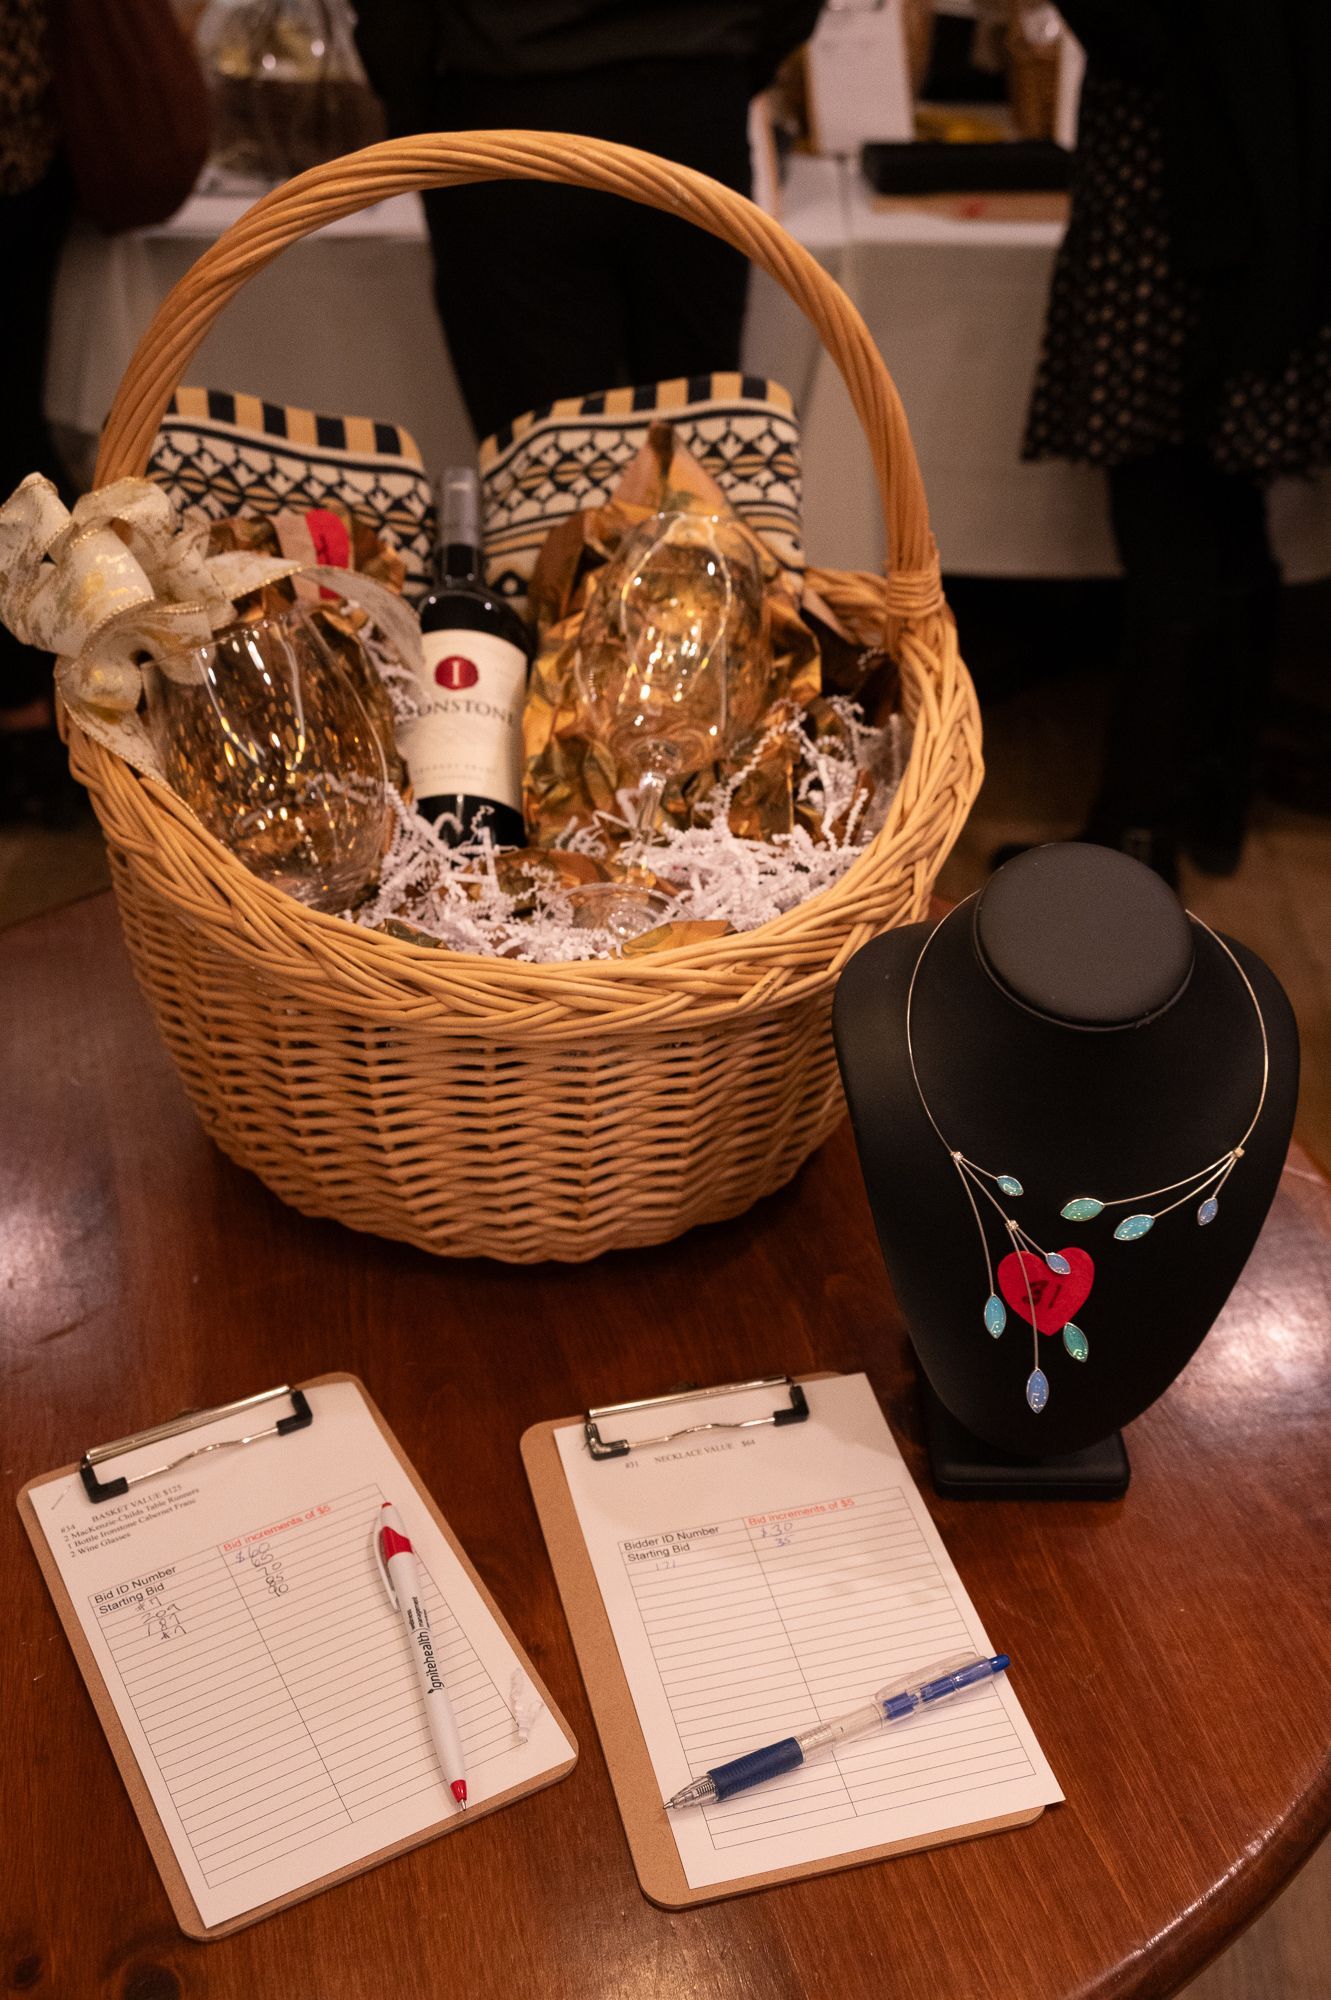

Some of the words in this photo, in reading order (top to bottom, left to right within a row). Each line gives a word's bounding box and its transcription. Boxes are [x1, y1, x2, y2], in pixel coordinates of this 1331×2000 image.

[414, 699, 514, 725] ONSTONE
[654, 1449, 702, 1464] NECKLACE
[703, 1443, 734, 1454] VALUE
[63, 1535, 69, 1543] 2
[146, 1501, 167, 1516] Table
[167, 1487, 200, 1504] Runners
[91, 1505, 129, 1523] BASKET
[130, 1492, 161, 1508] VALUE
[163, 1484, 182, 1496] $125
[749, 1516, 767, 1526] Bid
[768, 1504, 826, 1521] increments
[828, 1501, 838, 1511] of
[840, 1498, 856, 1509] $5
[73, 1534, 99, 1548] Bottle
[100, 1521, 137, 1539] Ironstone
[138, 1507, 174, 1523] Cabernet
[174, 1498, 197, 1511] Franc
[223, 1539, 242, 1552] Bid
[245, 1518, 303, 1543] increments
[304, 1510, 317, 1521] of
[316, 1505, 331, 1515] $5
[70, 1550, 76, 1558] 2
[77, 1542, 99, 1556] Wine
[100, 1532, 132, 1548] Glasses
[624, 1538, 659, 1551] Bidder
[661, 1534, 675, 1544] ID
[676, 1526, 720, 1540] Number
[627, 1548, 671, 1562] Starting
[672, 1542, 690, 1554] Bid
[95, 1590, 114, 1604] Bid
[116, 1584, 130, 1596] ID
[132, 1566, 176, 1589] Number
[99, 1592, 144, 1615] Starting
[145, 1583, 165, 1596] Bid
